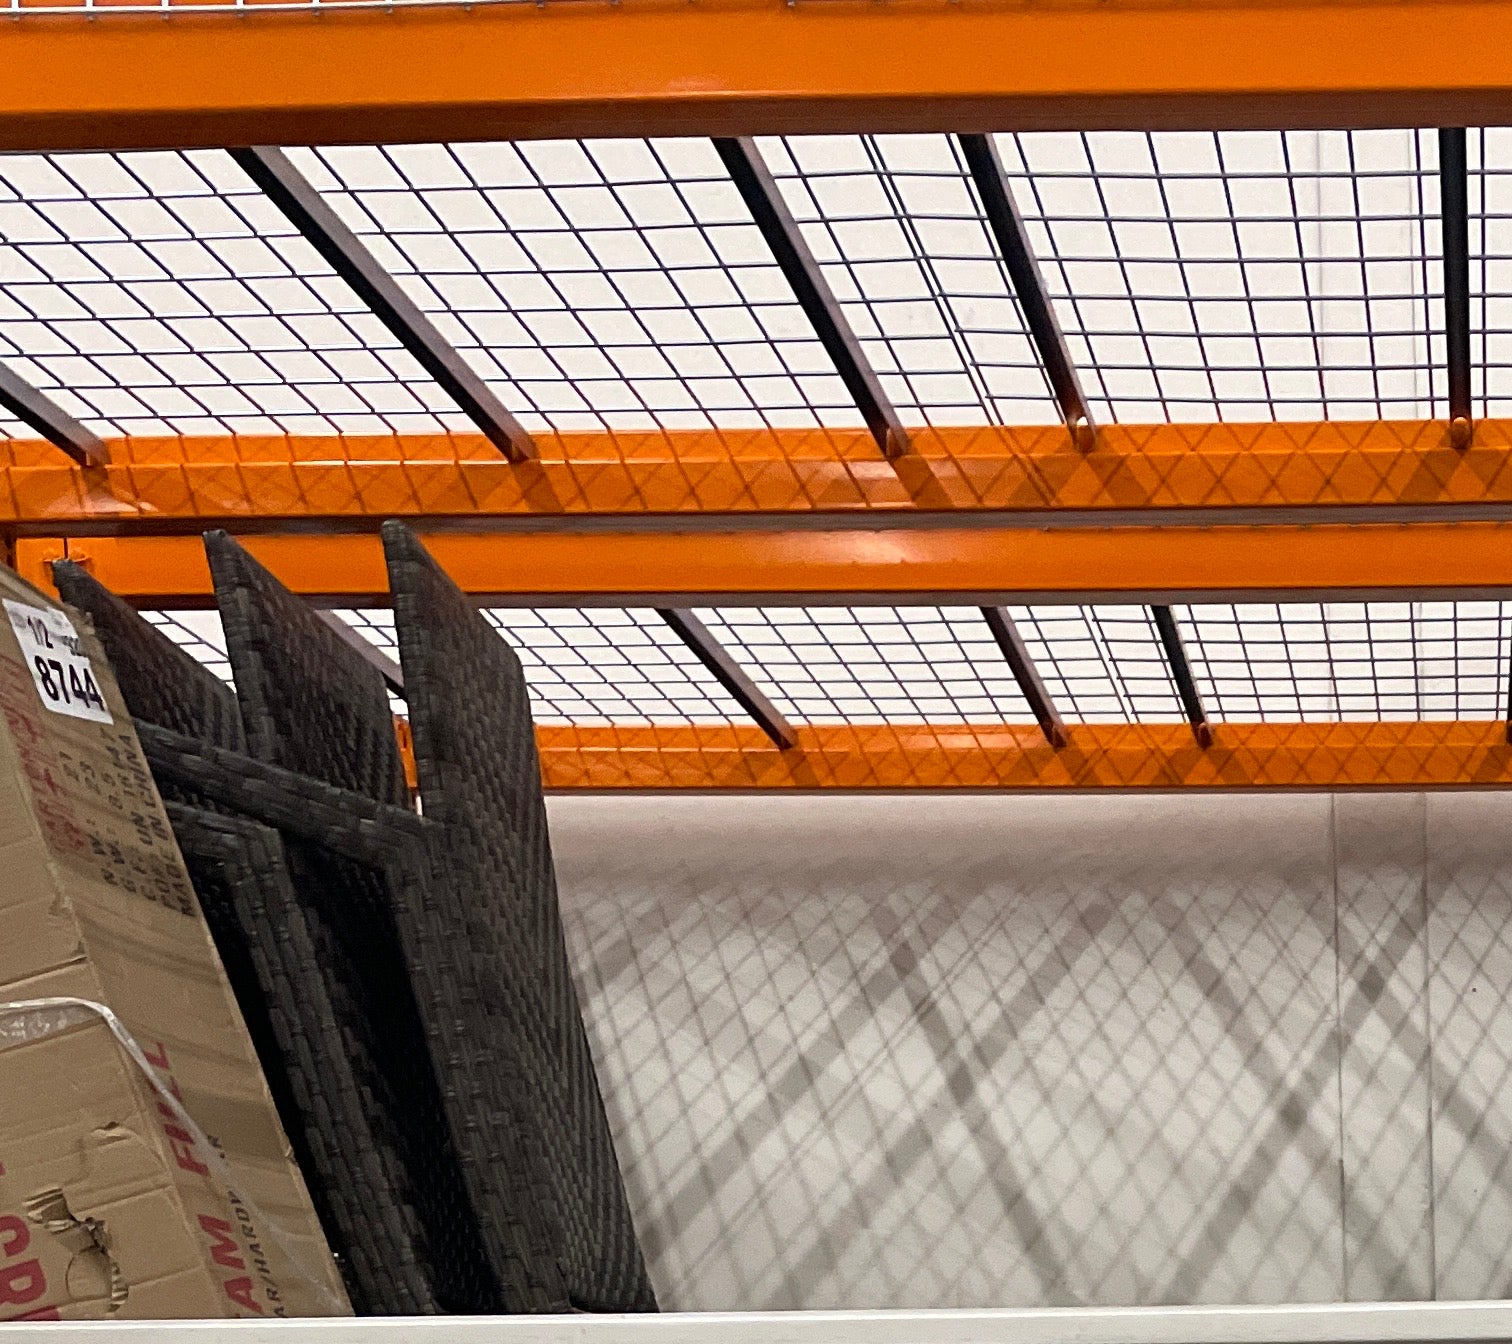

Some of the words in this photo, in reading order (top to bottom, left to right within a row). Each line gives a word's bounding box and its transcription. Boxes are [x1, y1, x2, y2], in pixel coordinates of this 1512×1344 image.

[34, 655, 105, 712] 8744
[118, 734, 156, 808] CHINA
[148, 815, 168, 840] IN
[197, 1213, 265, 1318] AM
